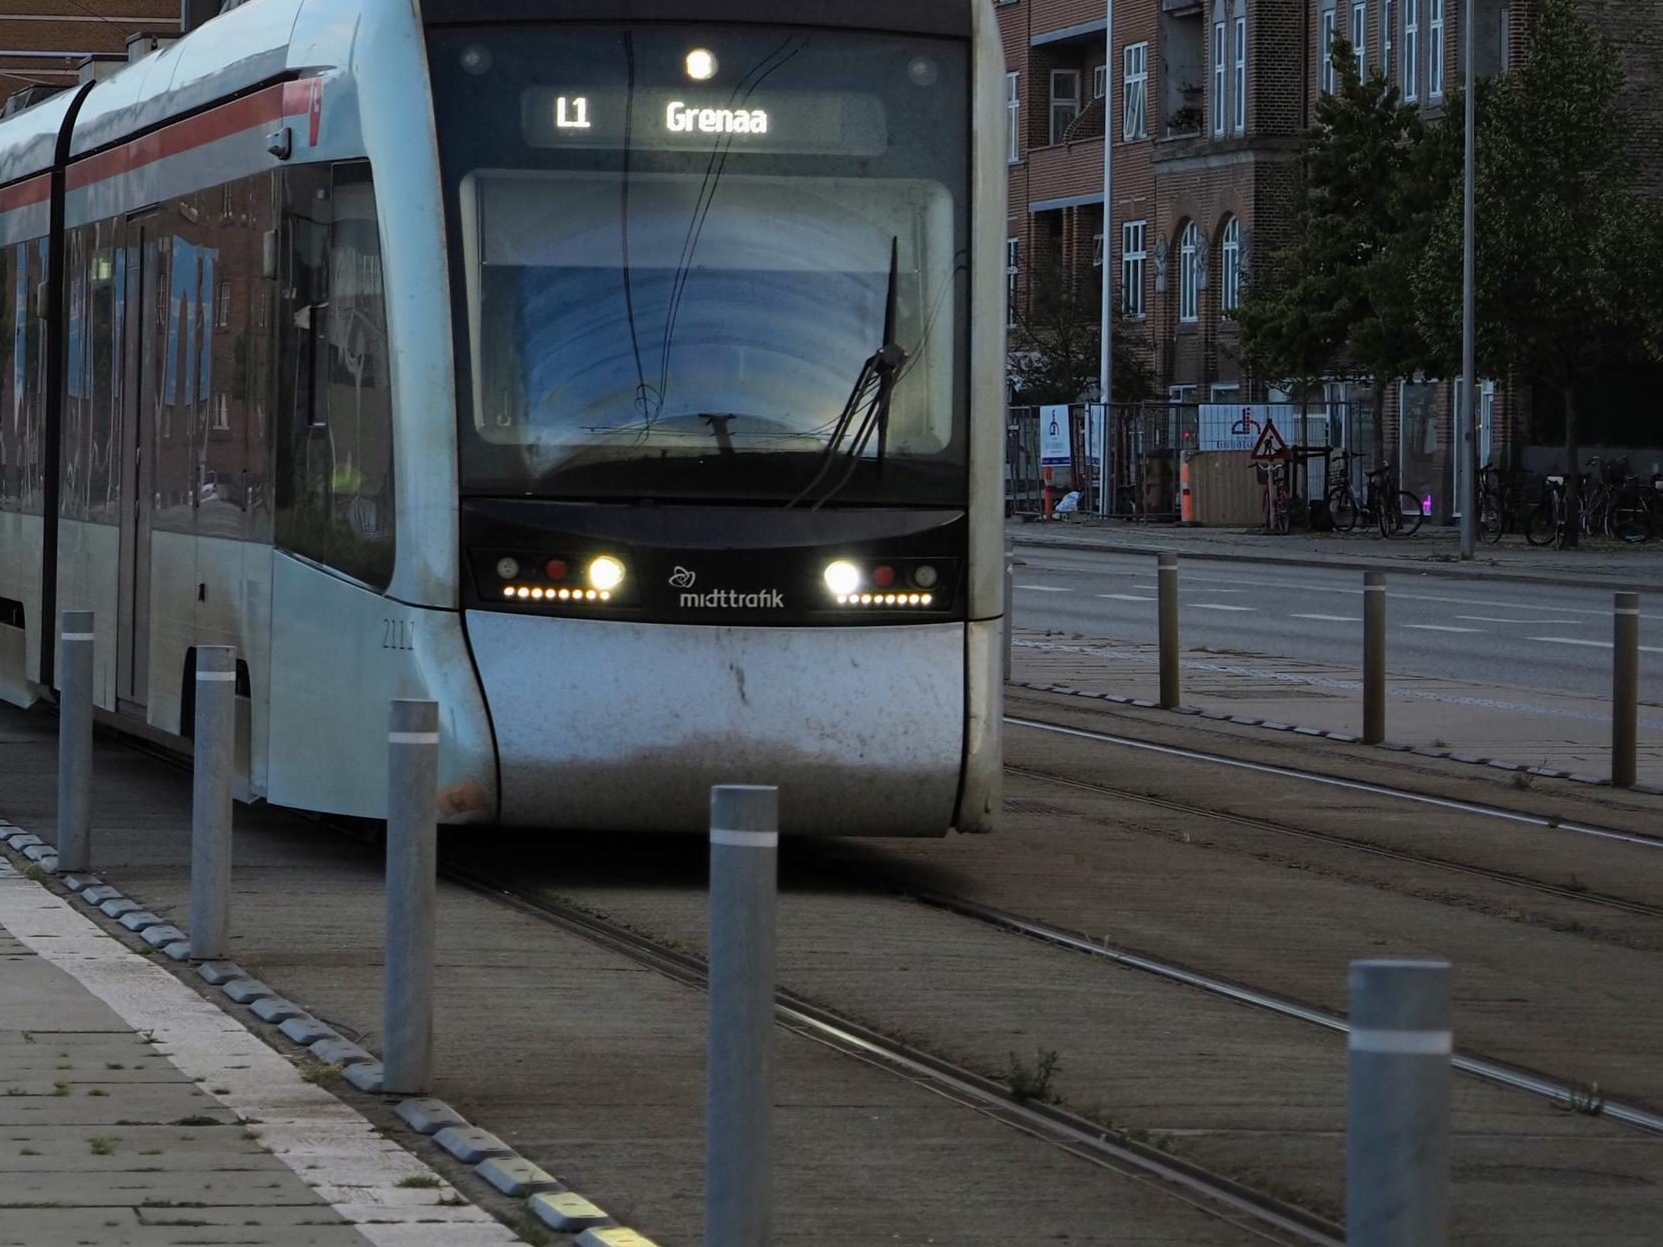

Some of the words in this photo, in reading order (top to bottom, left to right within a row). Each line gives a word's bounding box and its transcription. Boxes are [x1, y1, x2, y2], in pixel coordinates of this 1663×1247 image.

[556, 97, 592, 129] L1
[666, 100, 769, 135] Grenaa
[679, 588, 785, 608] midttrafik
